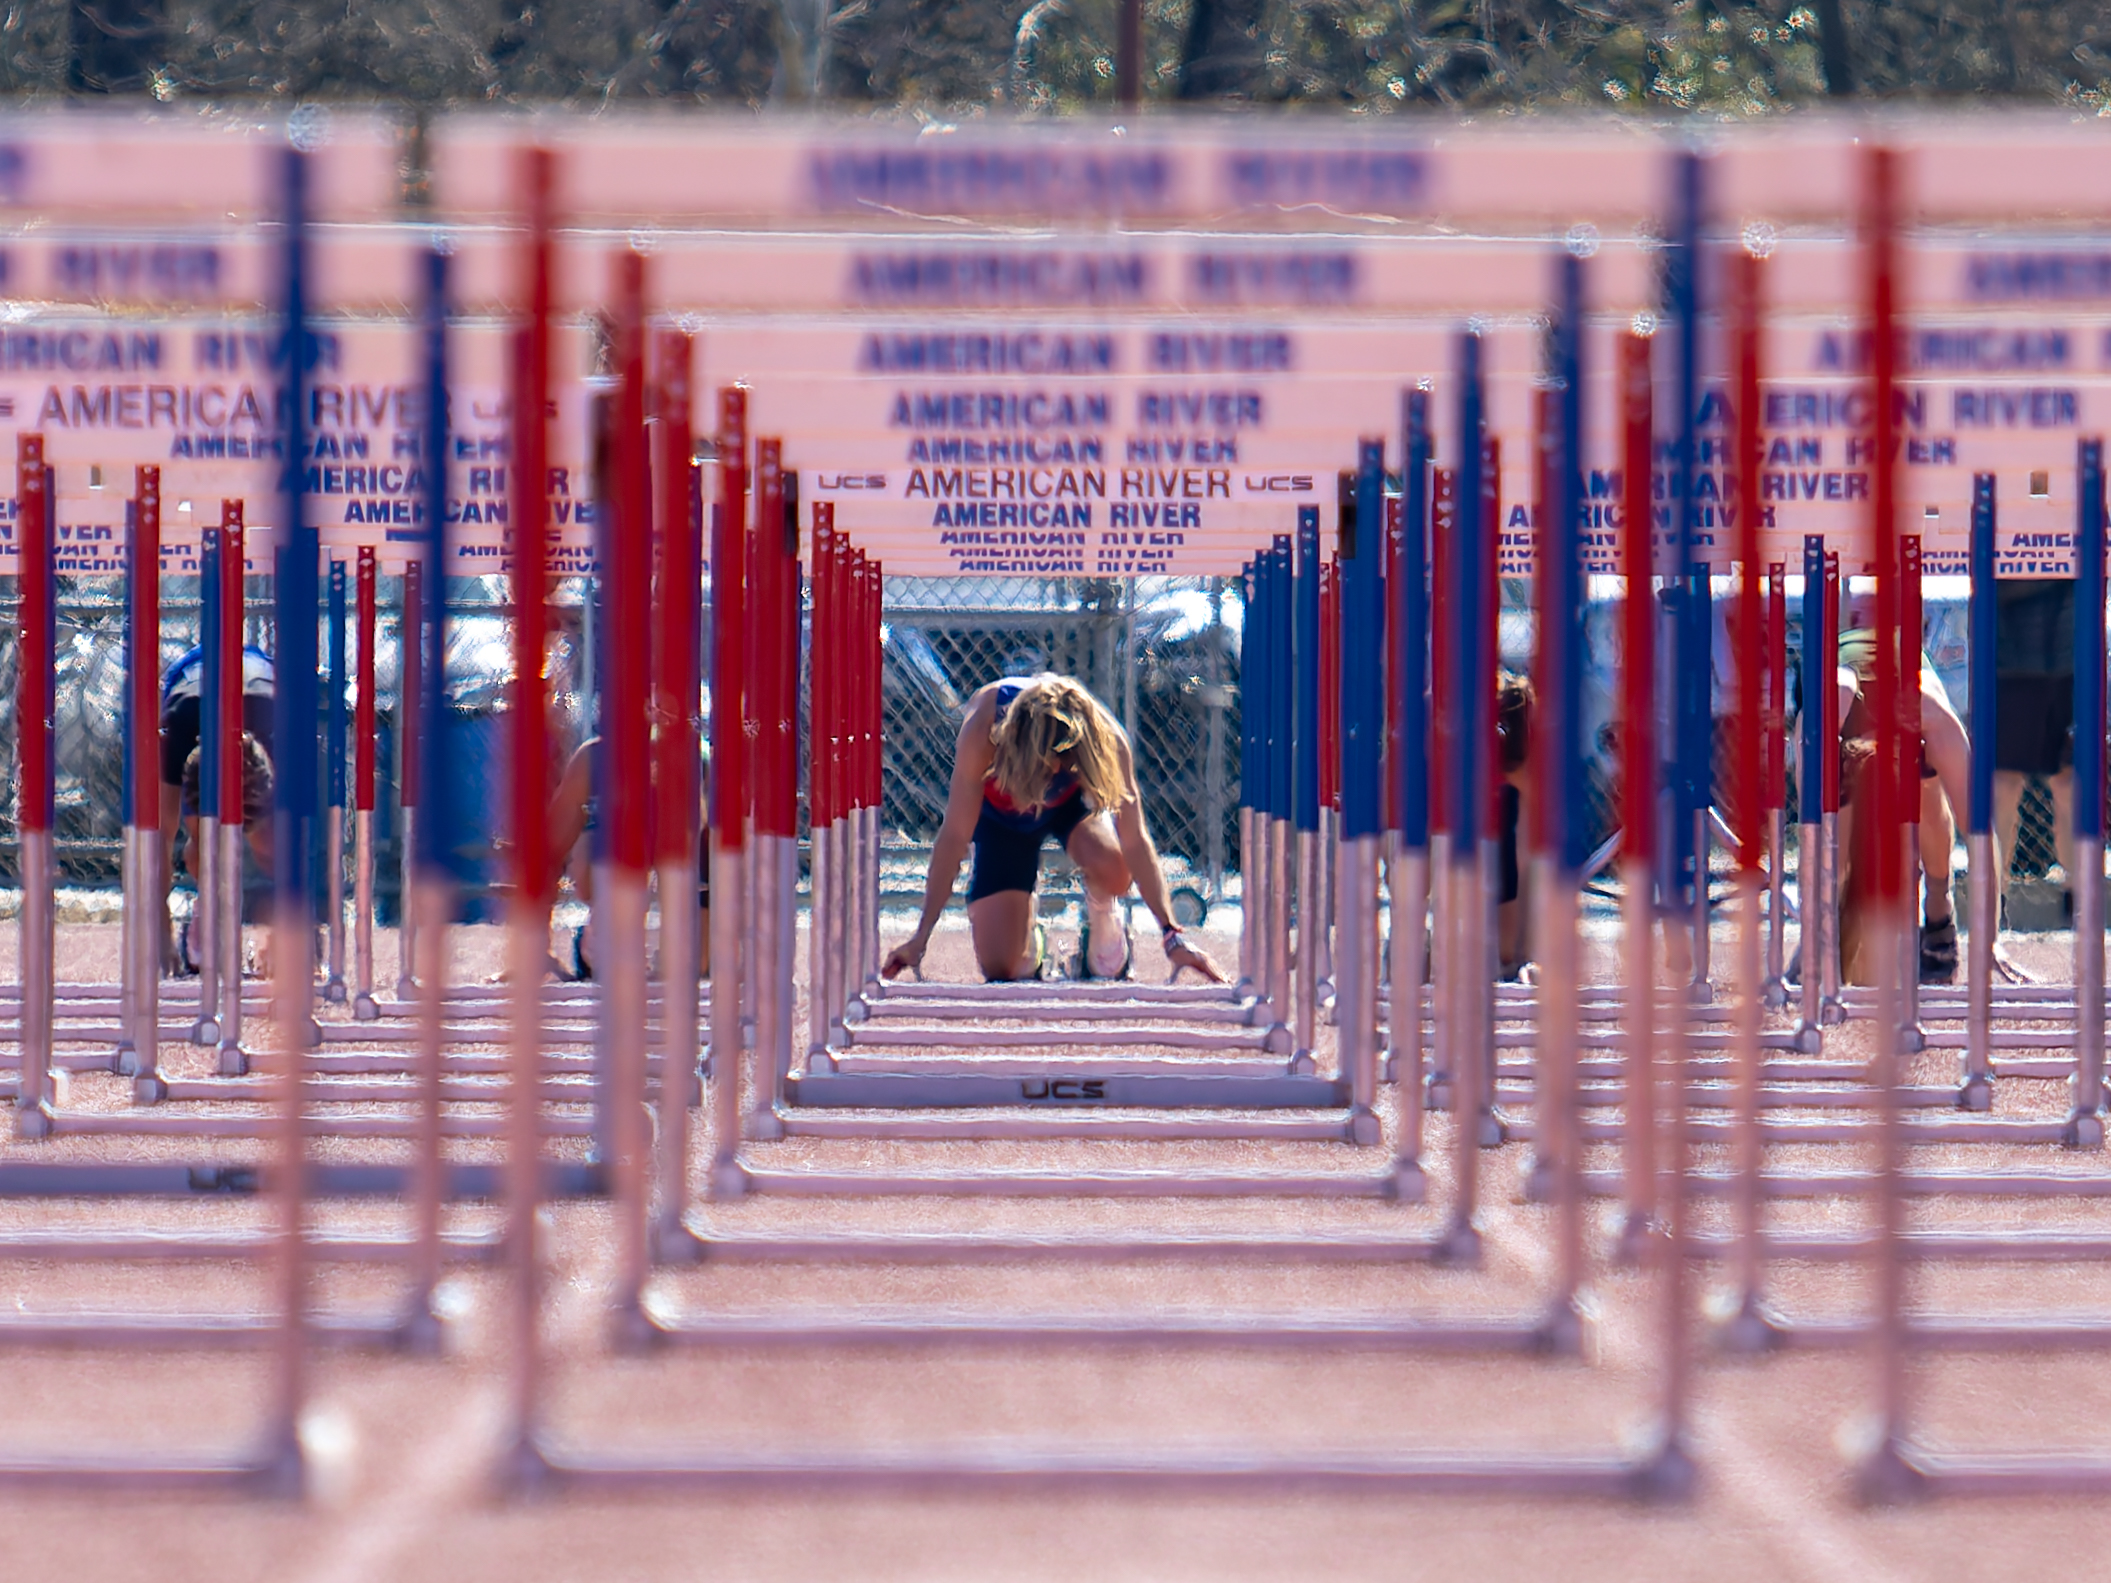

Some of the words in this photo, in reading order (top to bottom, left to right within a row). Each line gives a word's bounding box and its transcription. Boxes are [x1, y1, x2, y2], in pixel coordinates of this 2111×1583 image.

[858, 333, 1117, 374] AMERICAN
[1145, 332, 1293, 371] RIVER
[311, 384, 452, 428] RIVE
[889, 391, 1112, 428] AMERICAN
[1138, 391, 1263, 427] RIVER
[1955, 390, 2079, 428] RIVER
[907, 436, 1104, 464] AMERICAN
[1126, 436, 1240, 464] RIVER
[469, 467, 569, 495] RIR
[818, 474, 886, 490] UCS
[904, 469, 1106, 499] AMERICAN
[1120, 469, 1231, 499] RIVER
[1245, 475, 1313, 491] UCS
[1762, 472, 1869, 500] RIVER
[932, 502, 1092, 528] AMERICAN
[1109, 502, 1201, 528] RIVER
[1021, 1080, 1107, 1099] UCS
